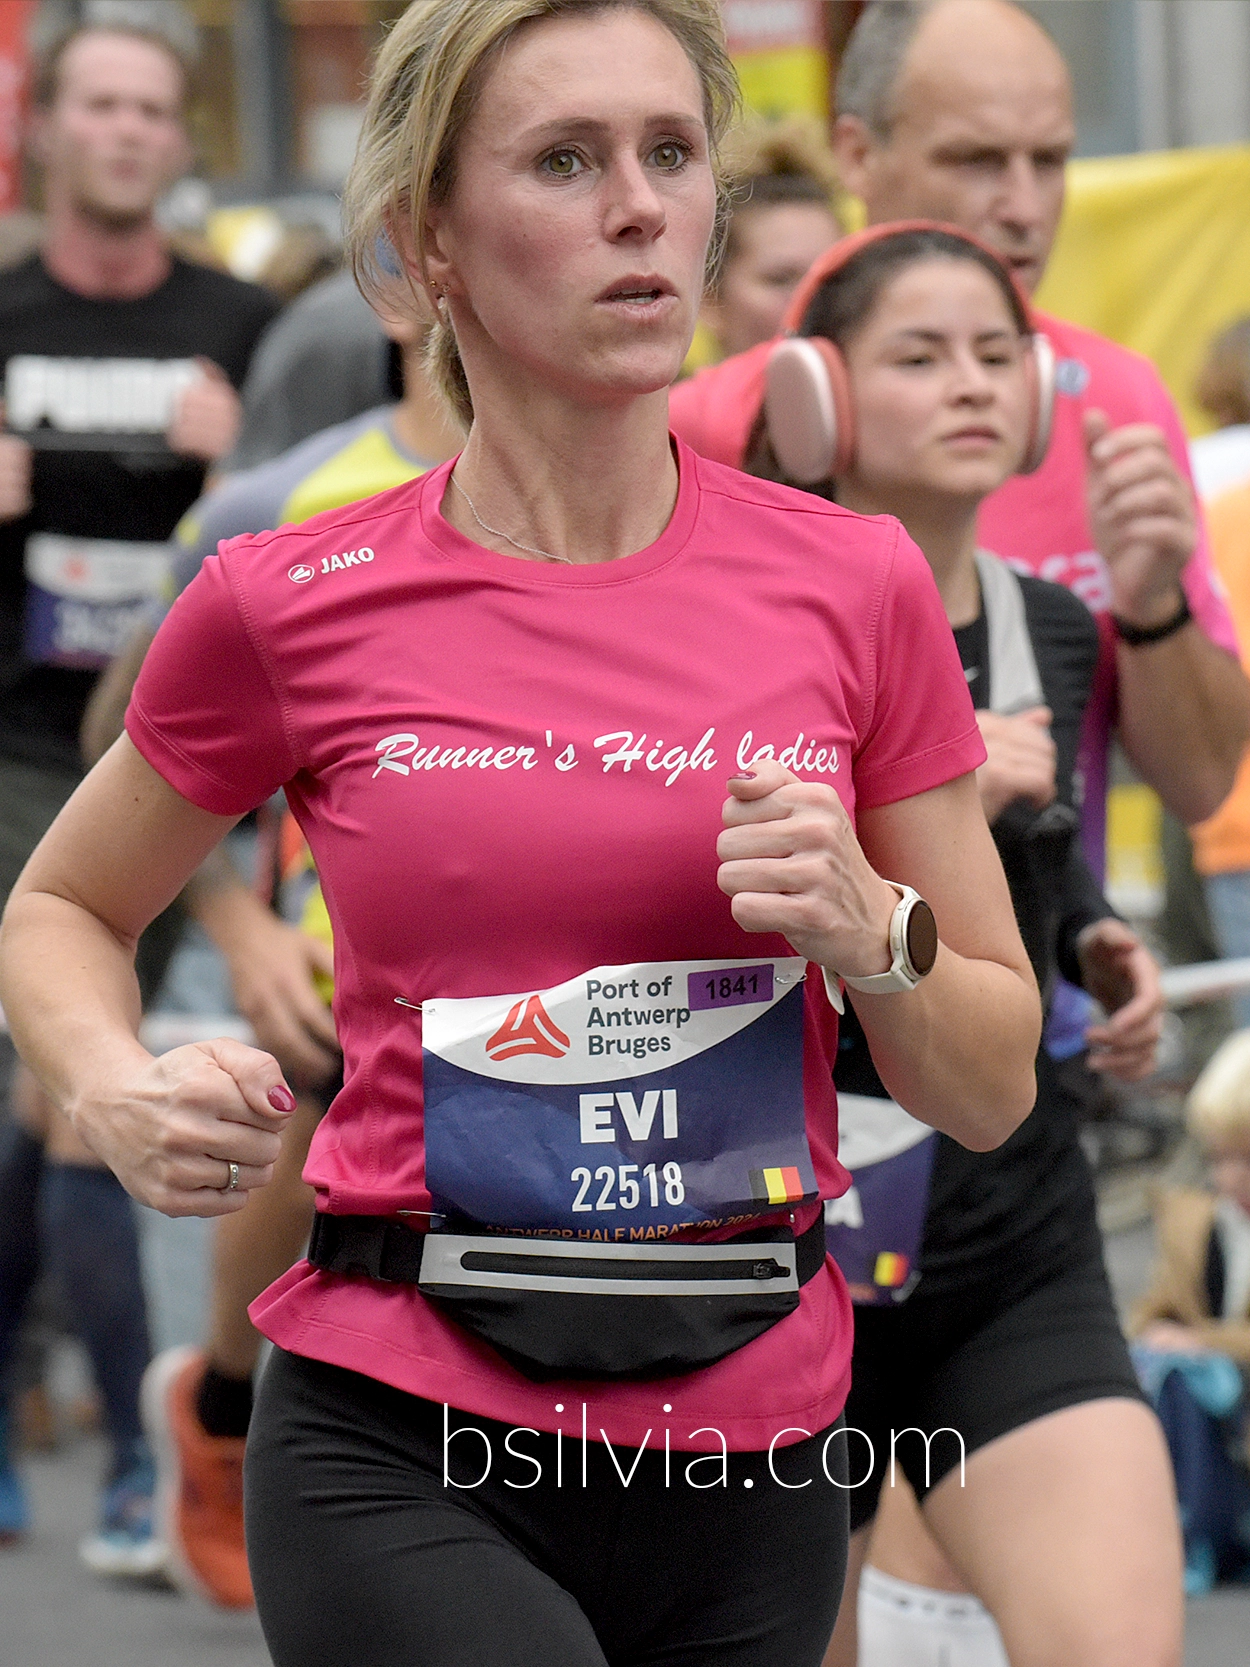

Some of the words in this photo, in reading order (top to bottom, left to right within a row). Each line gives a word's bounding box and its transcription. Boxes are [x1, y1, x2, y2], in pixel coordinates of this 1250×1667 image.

[321, 547, 375, 574] JAKO
[372, 730, 578, 779] Runner's
[593, 727, 718, 787] High
[736, 730, 840, 774] ladies
[586, 979, 639, 1000] Port
[646, 976, 672, 996] of
[705, 974, 758, 1000] 1841
[586, 1007, 690, 1028] Antwerp
[588, 1035, 671, 1058] Bruges
[580, 1089, 678, 1143] EVI
[571, 1161, 685, 1212] 22518
